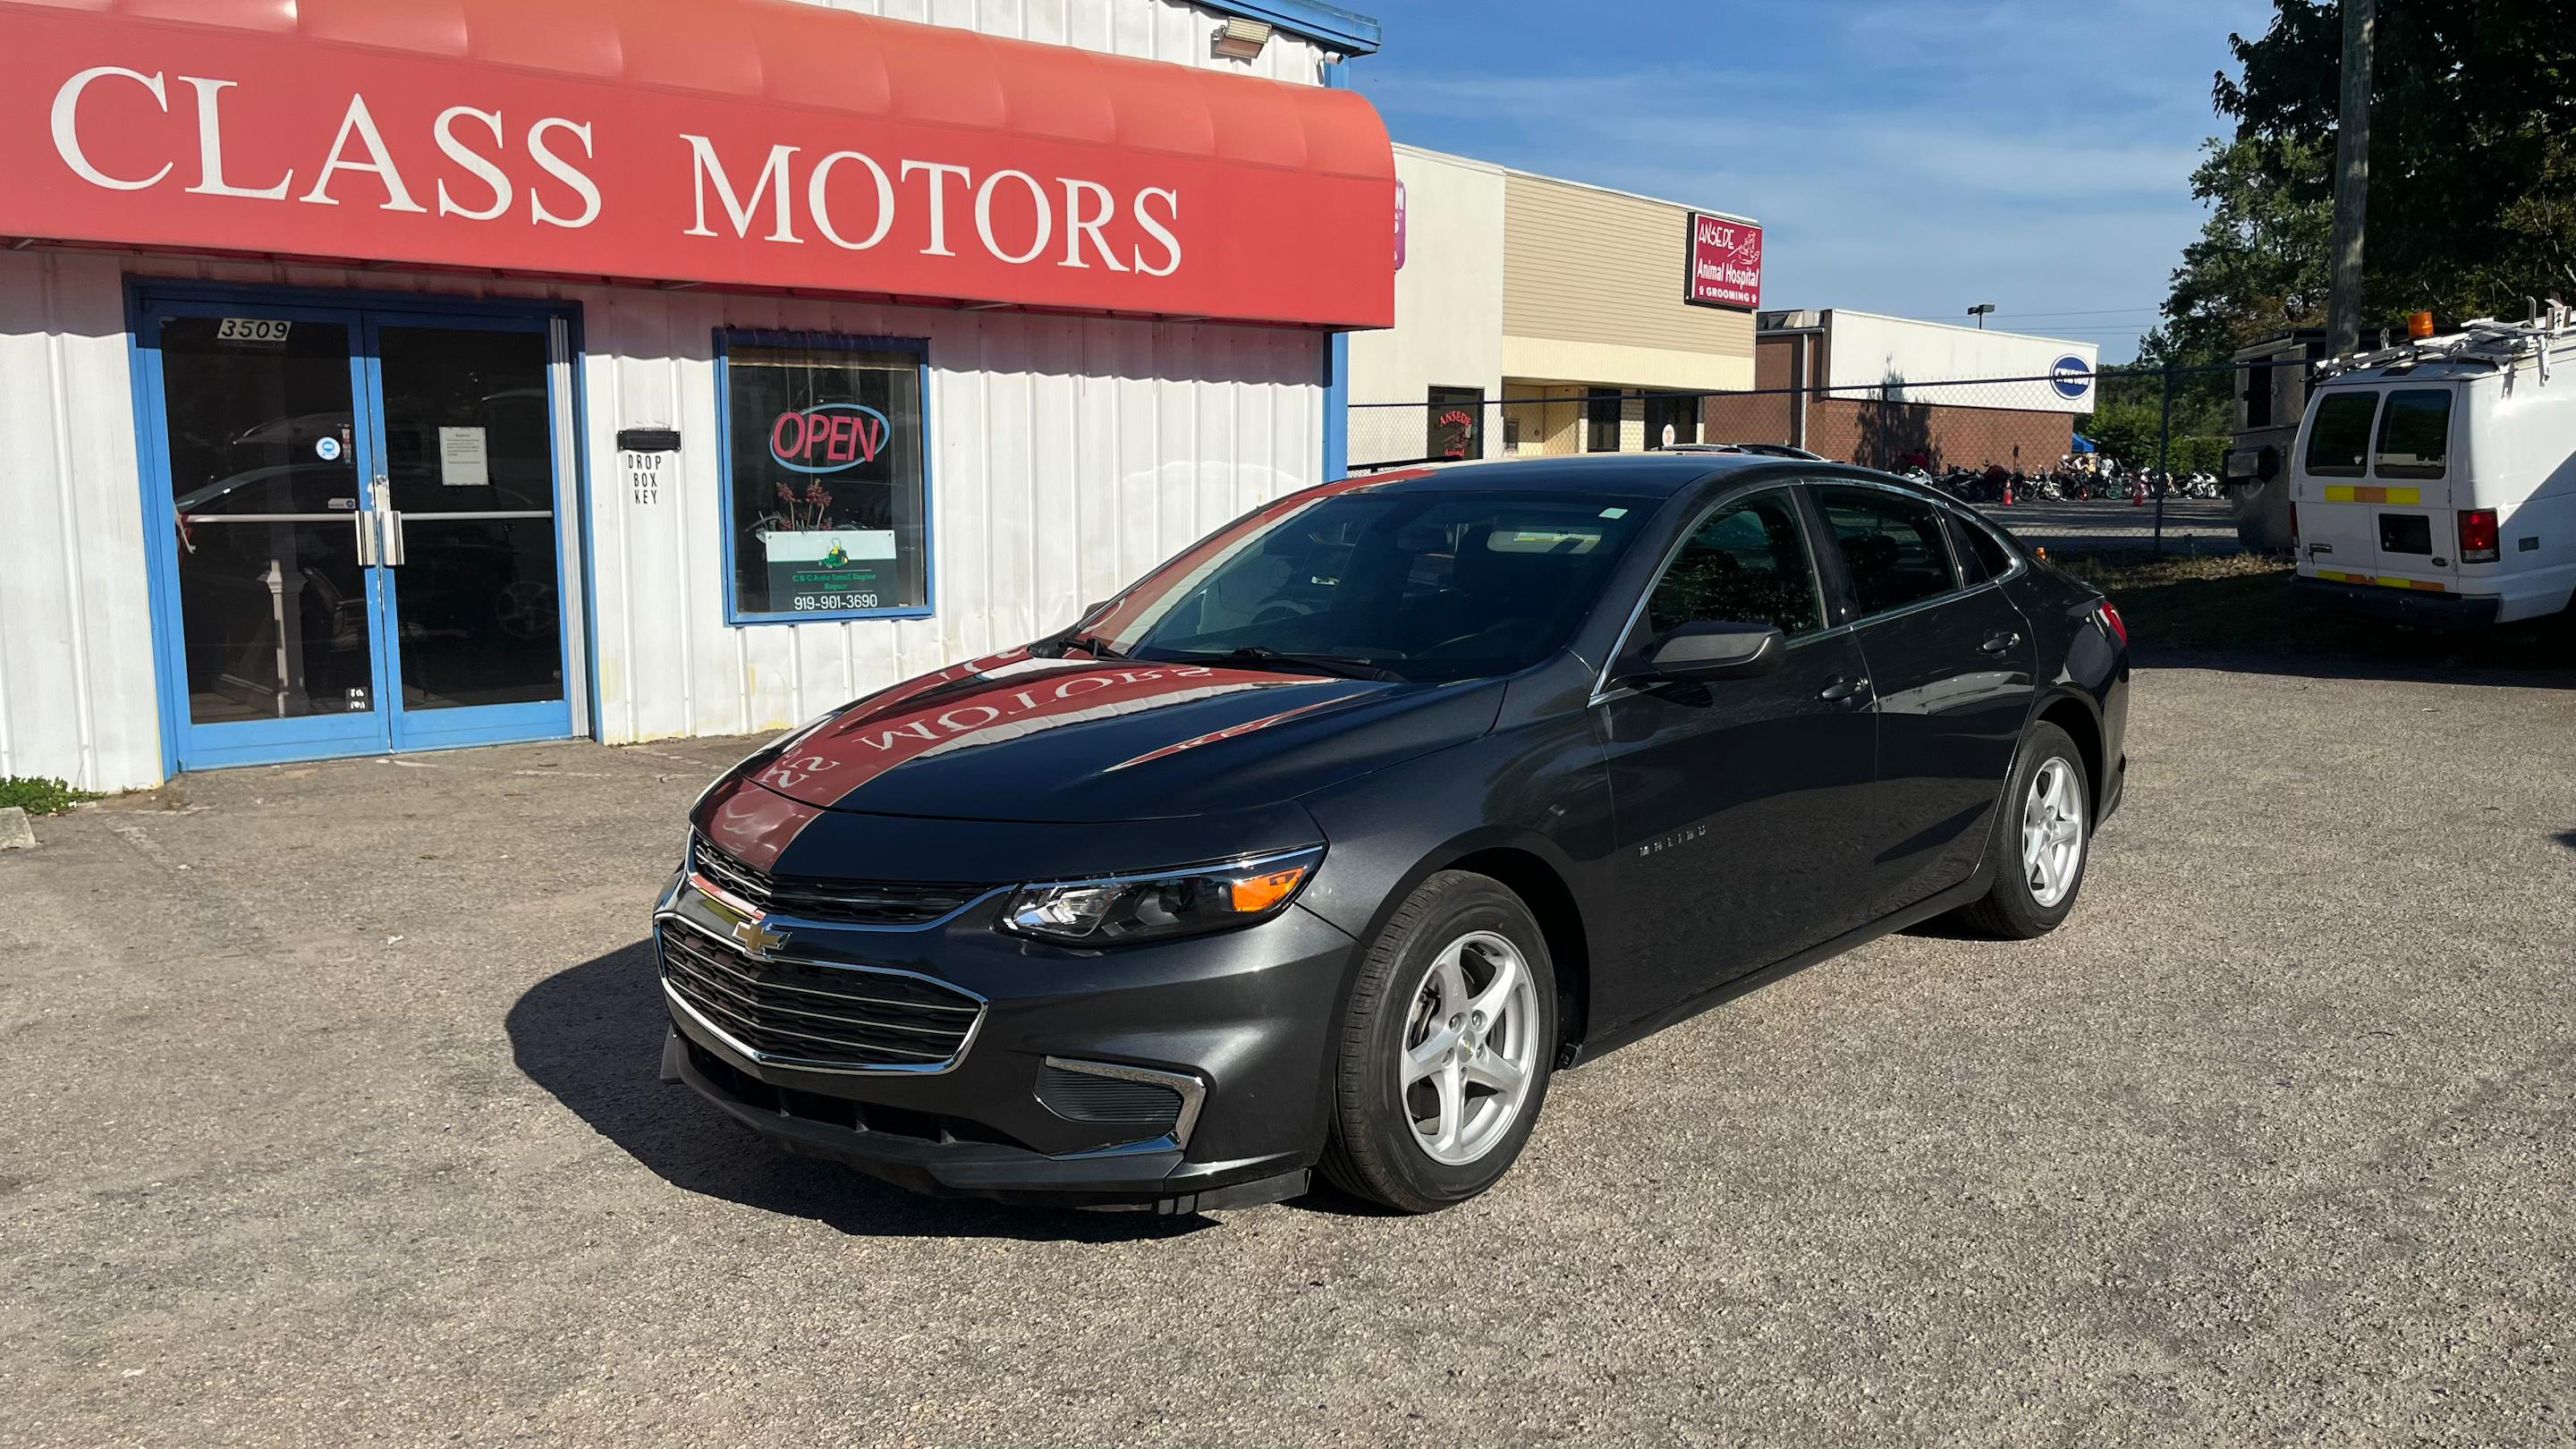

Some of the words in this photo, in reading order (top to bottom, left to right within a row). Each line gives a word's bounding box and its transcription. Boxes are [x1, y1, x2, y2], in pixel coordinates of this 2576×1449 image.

[50, 65, 603, 230] CLASS
[678, 132, 1182, 278] MOTORS
[1698, 221, 1735, 250] ANSEDE
[1696, 258, 1724, 283] Animal
[1724, 261, 1760, 291] Hospital
[1705, 286, 1750, 302] GROOMING
[221, 320, 288, 339] 3509
[1439, 410, 1472, 428] ANSEDE
[773, 411, 879, 462] OPEN
[628, 453, 662, 470] DROP
[633, 471, 658, 488] BOX
[634, 488, 657, 505] KEY
[793, 593, 878, 610] 919-901-3690
[1639, 824, 1707, 858] MALIBU
